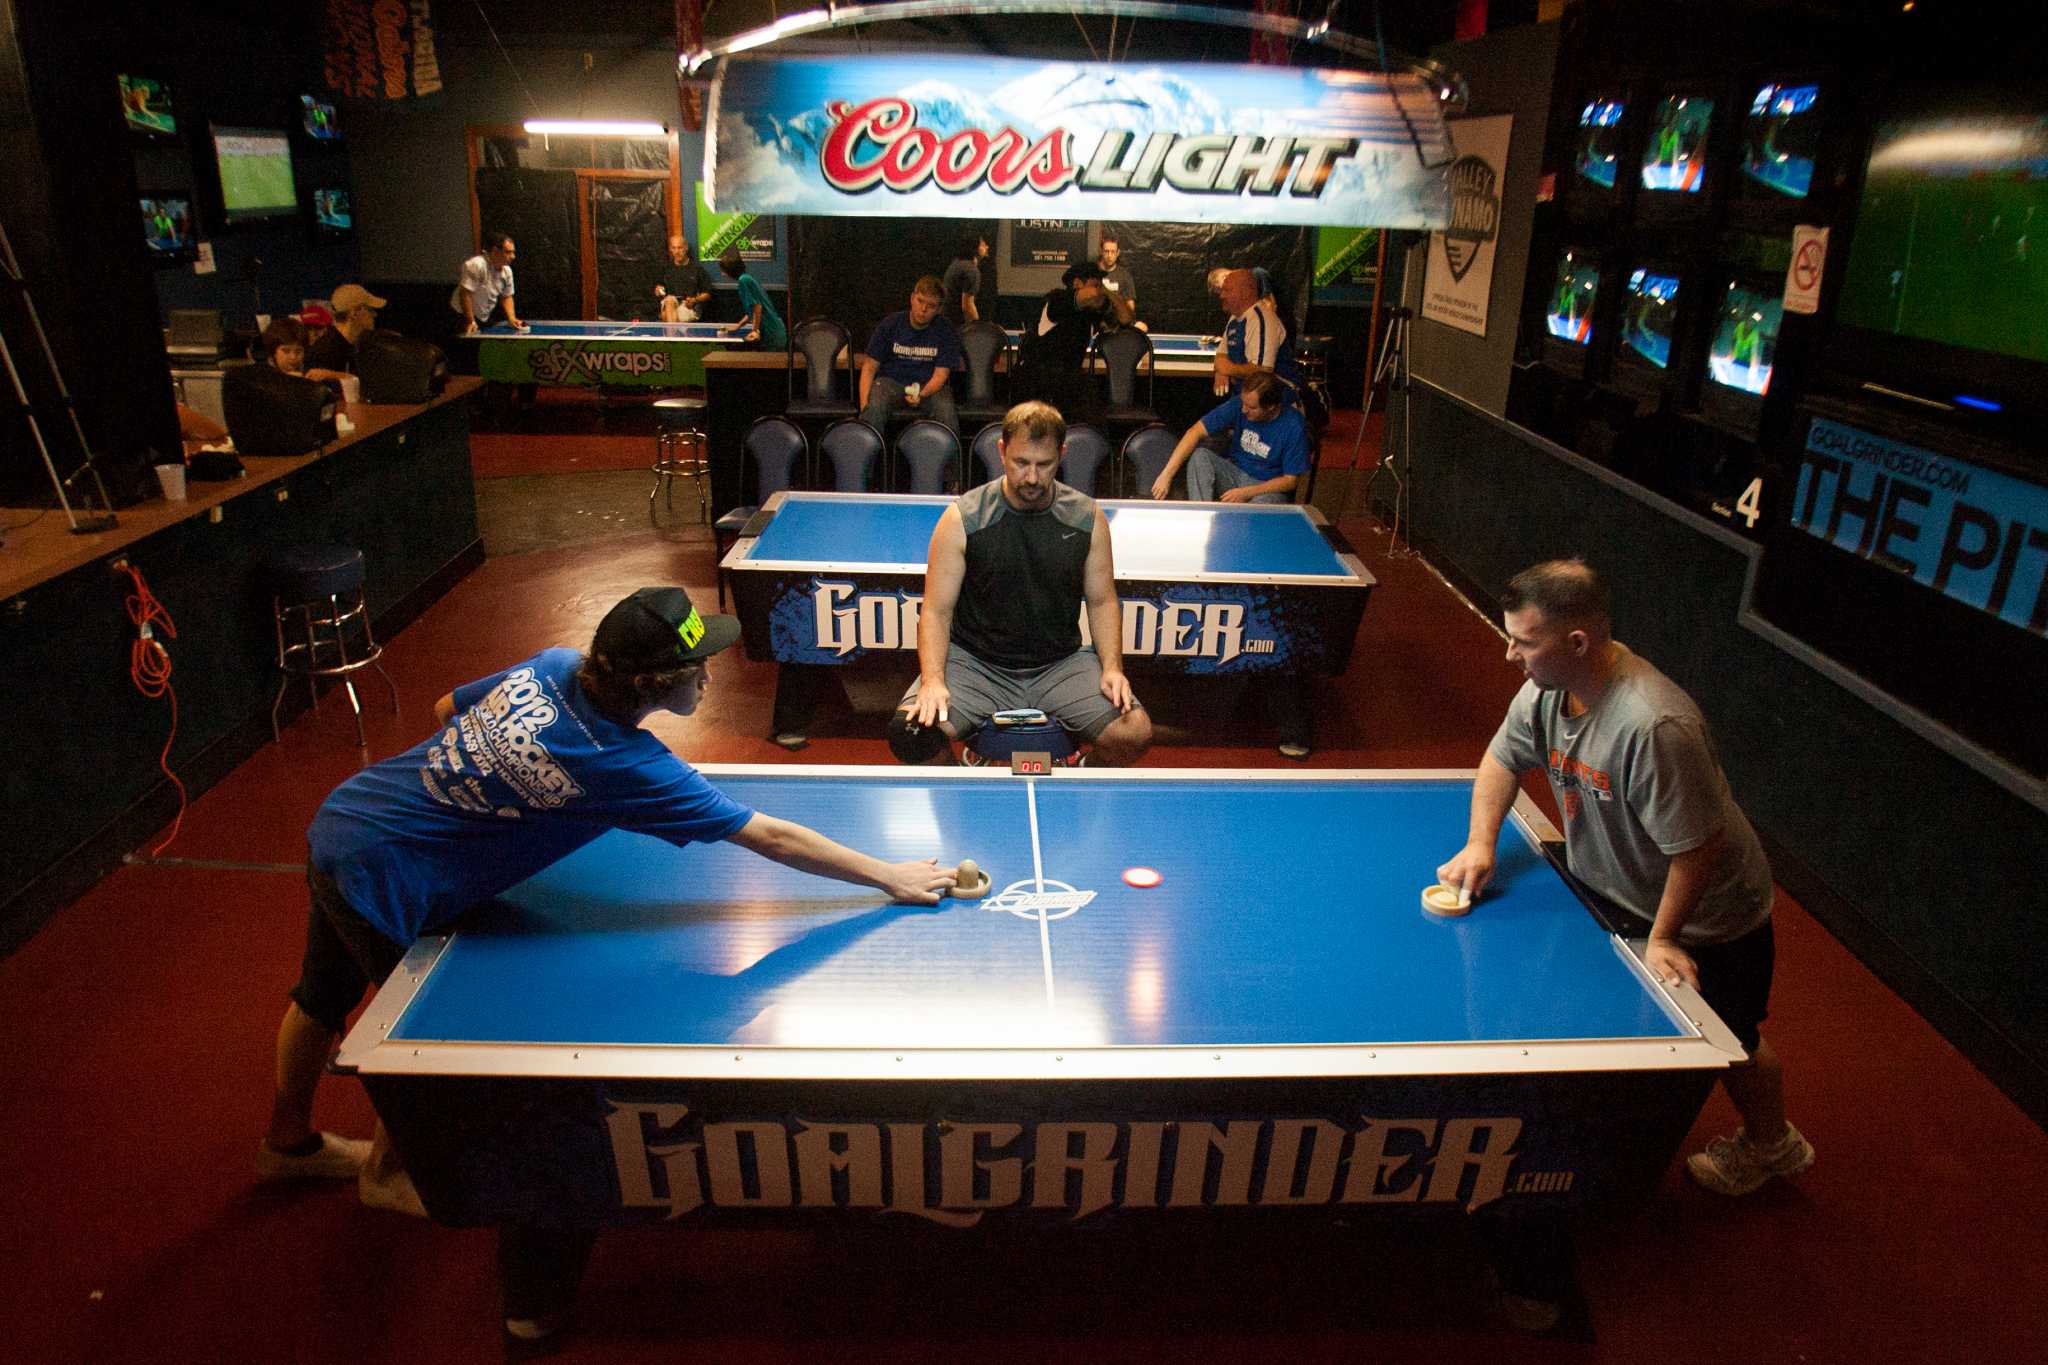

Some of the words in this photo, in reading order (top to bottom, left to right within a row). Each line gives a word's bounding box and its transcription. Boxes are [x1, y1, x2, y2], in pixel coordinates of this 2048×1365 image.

[820, 97, 1076, 195] Coors
[1075, 129, 1359, 198] LIGHT
[1736, 478, 1763, 528] 4
[1799, 450, 1933, 577] THE
[502, 667, 557, 732] 2012
[499, 713, 582, 798] HOCKEY
